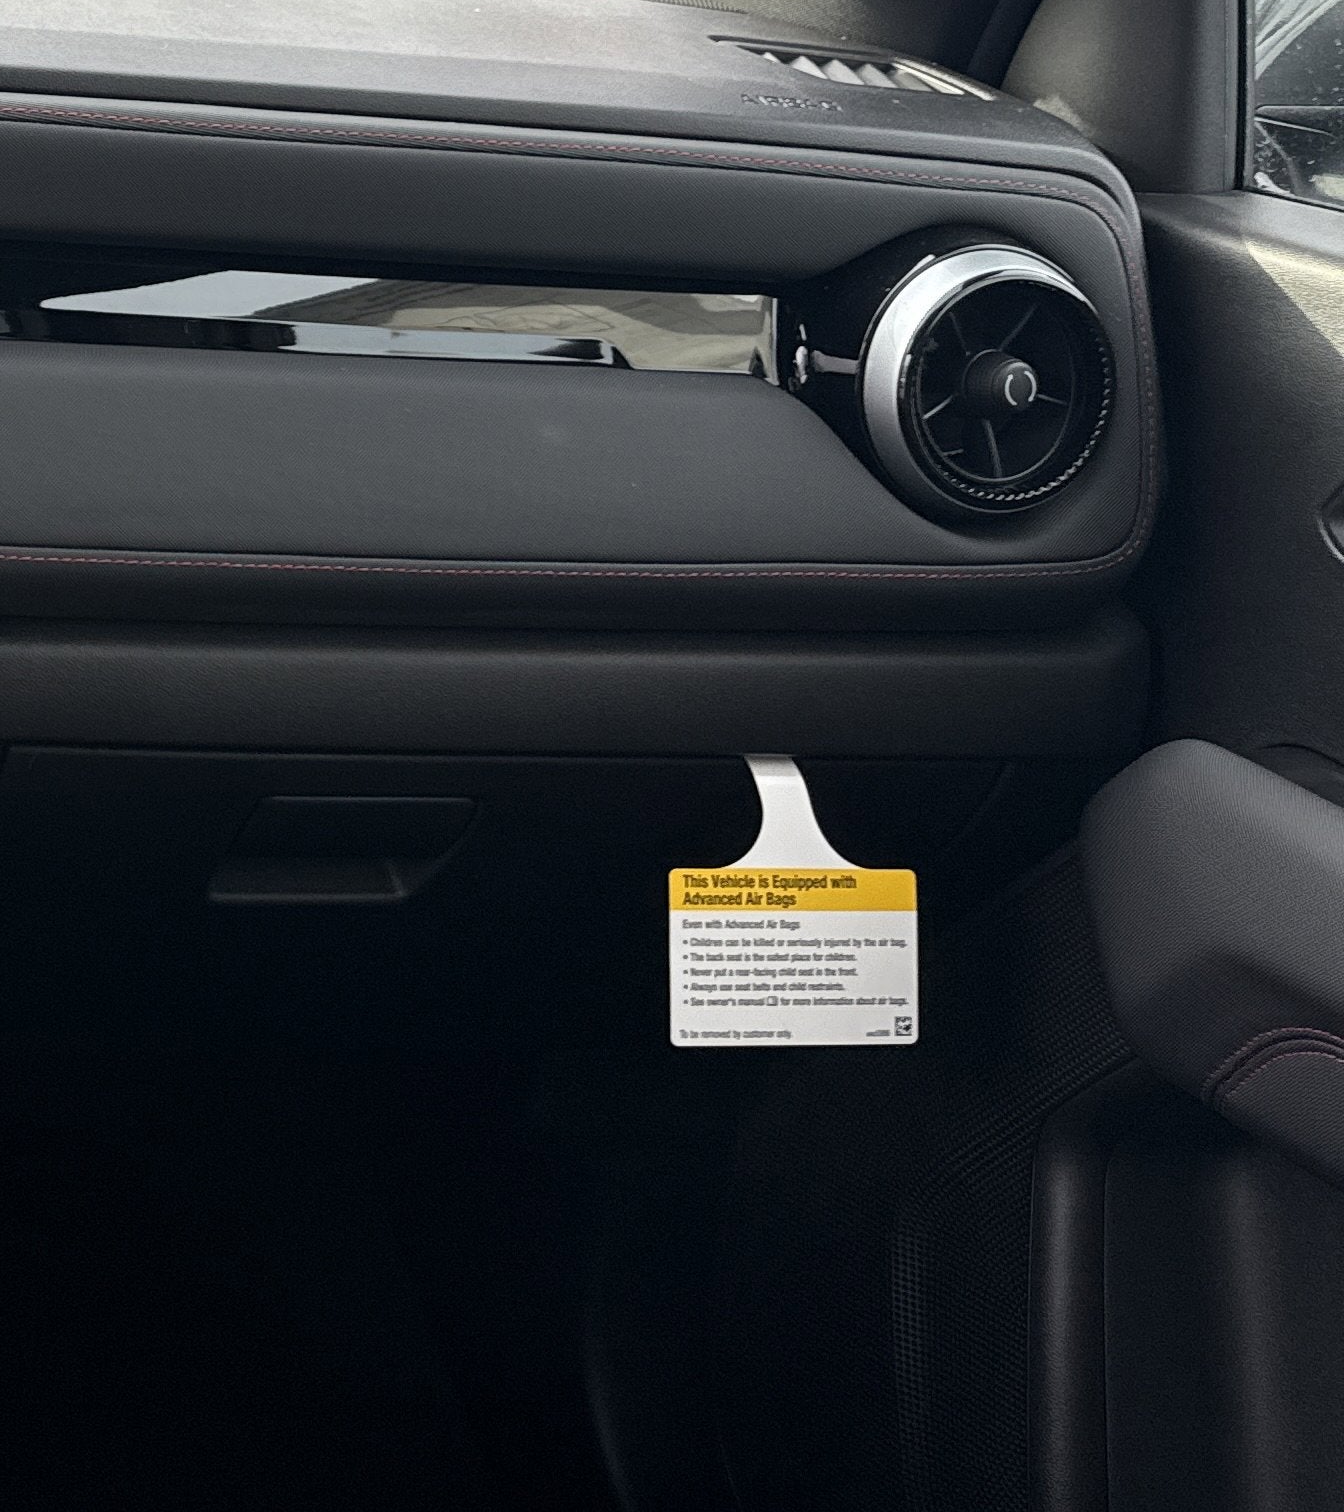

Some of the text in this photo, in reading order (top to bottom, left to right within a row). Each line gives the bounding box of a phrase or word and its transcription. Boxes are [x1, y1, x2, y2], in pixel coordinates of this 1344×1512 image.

[682, 874, 857, 891] This Vehicle is Equipped with
[682, 891, 797, 908] Advanced Air Bags
[682, 919, 801, 931] Even with Advanced Air Bags
[690, 937, 723, 947] Children
[725, 939, 739, 947] can
[741, 937, 751, 947] be
[753, 937, 775, 947] killed
[777, 939, 785, 947] or
[787, 937, 821, 948] seriously
[824, 938, 851, 948] injured
[852, 938, 862, 948] by
[864, 938, 876, 947] the
[878, 938, 888, 947] air
[690, 952, 704, 961] The
[706, 952, 723, 961] back
[726, 953, 742, 961] seat
[752, 953, 765, 961] the
[766, 953, 789, 961] safest
[790, 953, 812, 963] place
[812, 953, 823, 961] for
[690, 968, 712, 976] Never
[714, 968, 727, 978] put
[778, 968, 796, 976] child
[824, 968, 836, 976] the
[690, 983, 717, 993] Always
[734, 983, 751, 991] seat
[773, 983, 787, 991] and
[788, 983, 806, 991] child
[679, 1029, 688, 1039] To
[690, 1030, 698, 1039] be
[701, 1030, 731, 1039] removed
[732, 1030, 741, 1040] by
